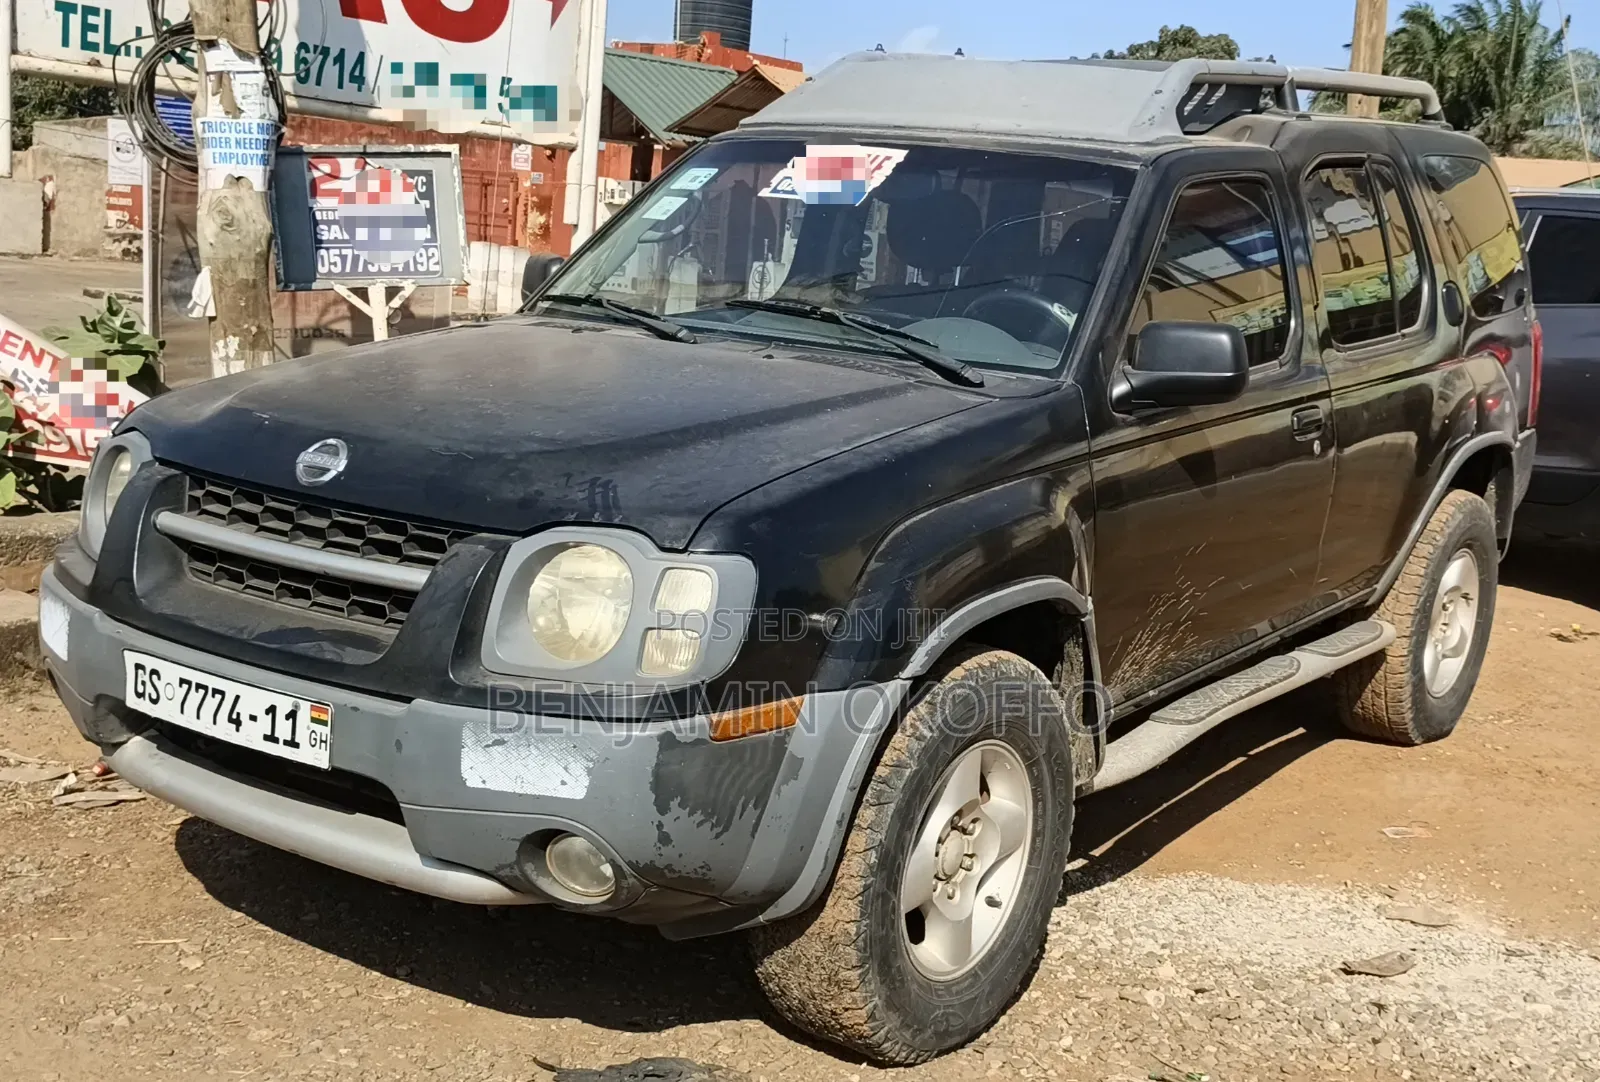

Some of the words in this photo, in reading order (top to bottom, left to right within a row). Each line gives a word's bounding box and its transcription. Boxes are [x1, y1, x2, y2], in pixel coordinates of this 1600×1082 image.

[200, 120, 255, 135] TRICYCLE
[134, 662, 161, 705] GS
[178, 677, 300, 749] 7774-11
[308, 729, 328, 751] GH
